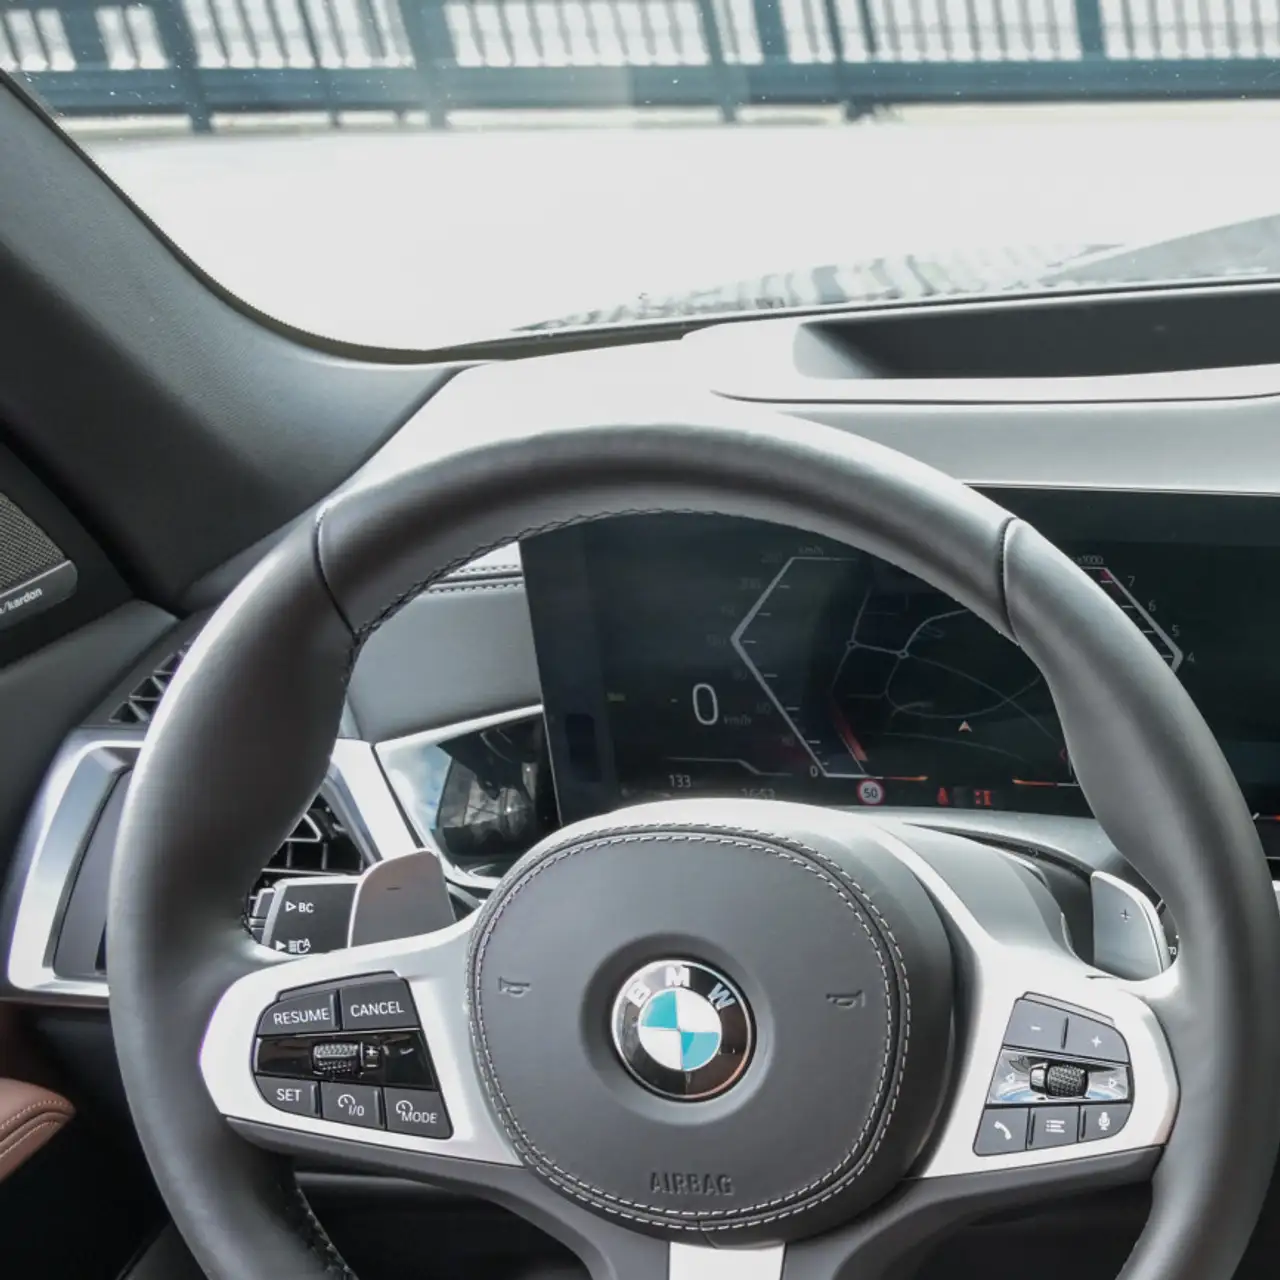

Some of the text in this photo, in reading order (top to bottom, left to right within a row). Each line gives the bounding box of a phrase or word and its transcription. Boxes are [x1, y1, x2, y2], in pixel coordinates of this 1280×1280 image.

[692, 682, 720, 726] 0
[668, 773, 692, 789] 133
[863, 786, 879, 799] 50
[298, 901, 315, 914] BC
[273, 1007, 331, 1026] RESUME
[350, 1000, 405, 1018] CANCEL
[276, 1087, 302, 1102] SET
[401, 1110, 438, 1124] MODE
[650, 1171, 735, 1196] AIRBAG
